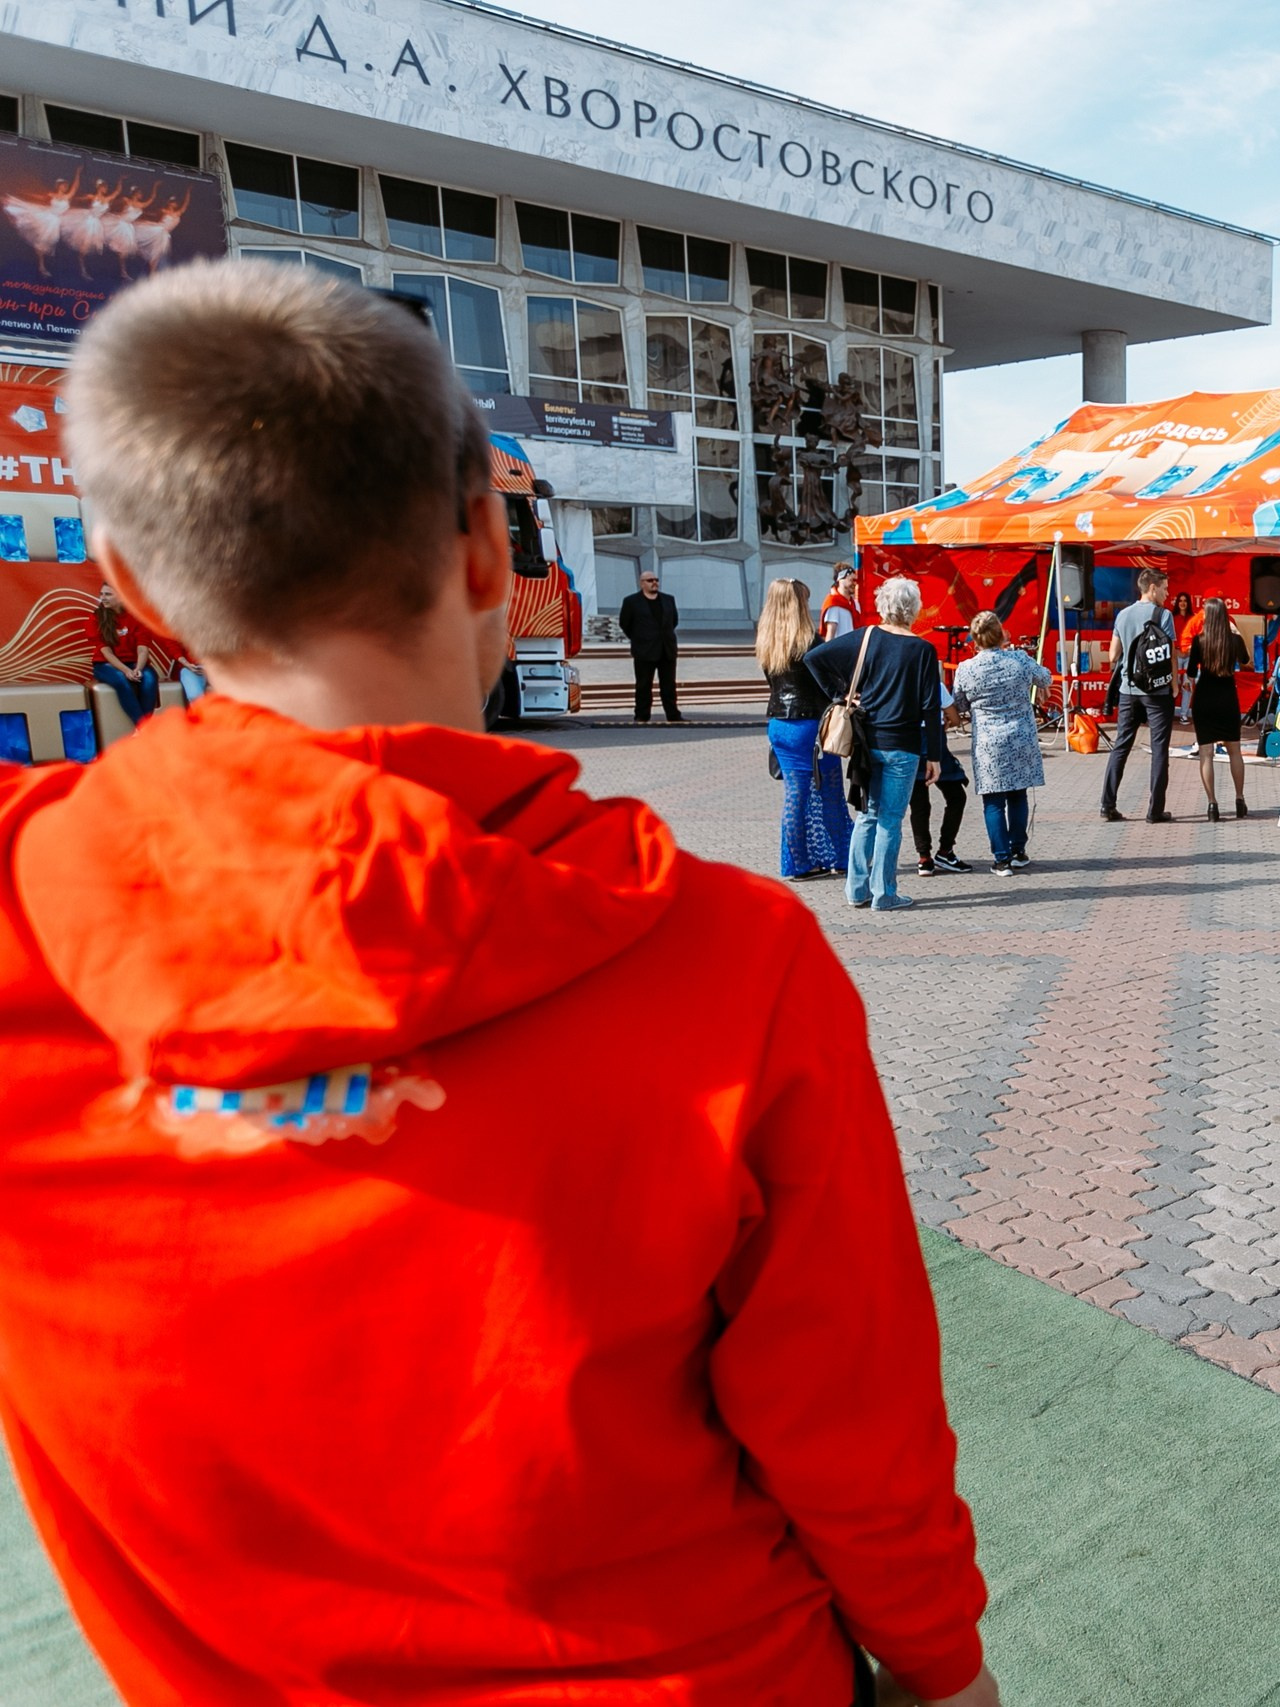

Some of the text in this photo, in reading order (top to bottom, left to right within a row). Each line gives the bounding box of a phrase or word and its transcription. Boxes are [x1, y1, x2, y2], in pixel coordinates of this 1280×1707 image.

[498, 63, 994, 223] ХВОРОСТОВСКОГО
[544, 403, 576, 415] Билеты:
[545, 414, 595, 427] territoryfest.ru
[546, 424, 591, 437] krasopera.ru
[1145, 643, 1171, 665] 937
